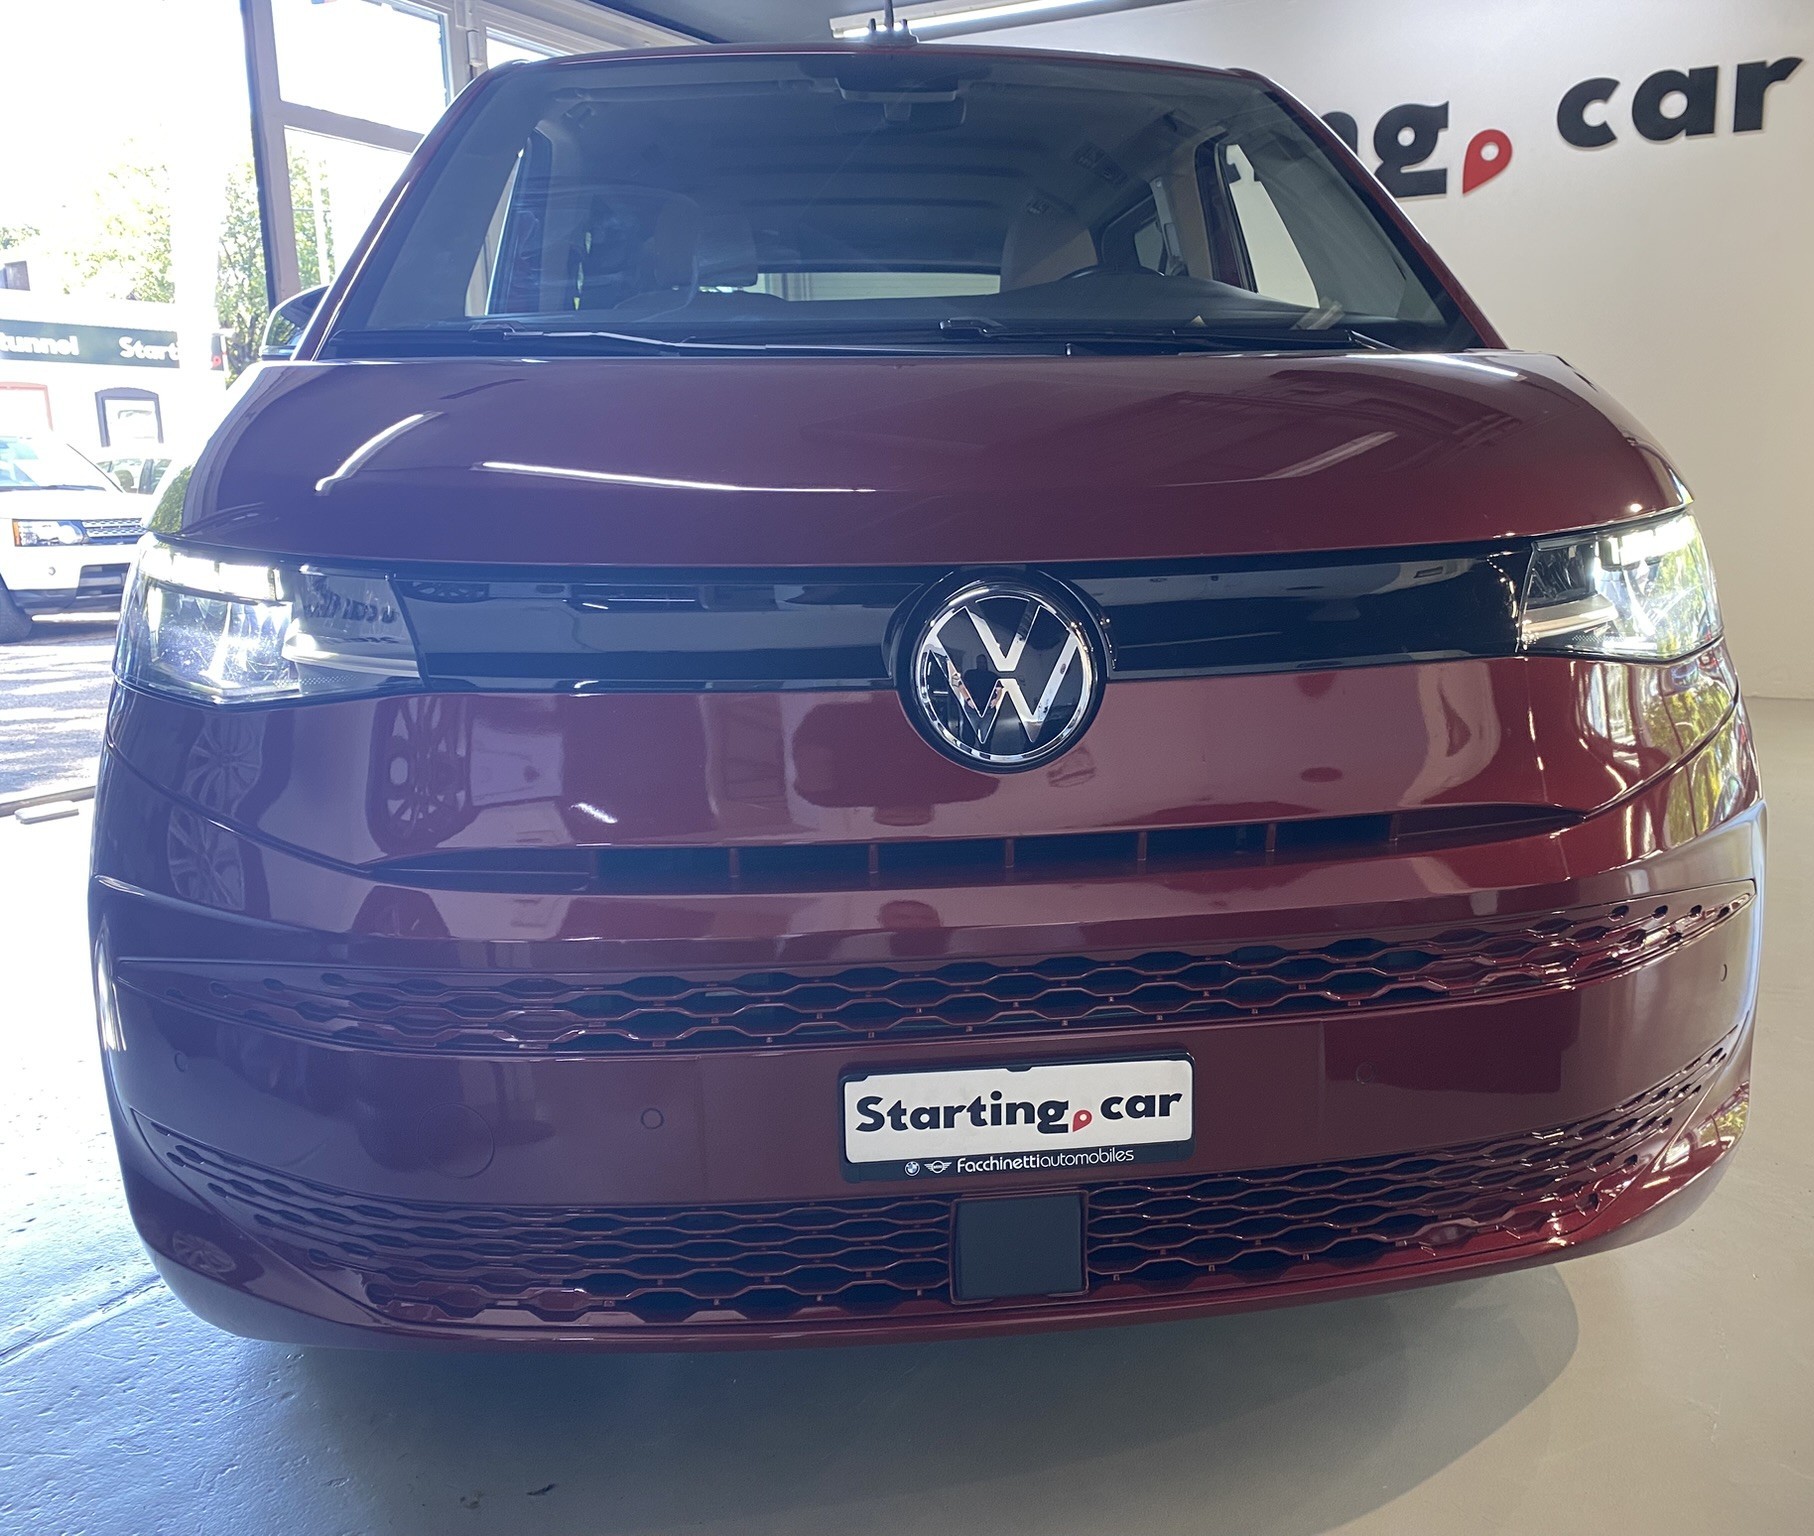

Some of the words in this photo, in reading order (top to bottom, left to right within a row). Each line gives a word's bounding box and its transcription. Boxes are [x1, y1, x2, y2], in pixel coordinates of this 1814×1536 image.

[1557, 57, 1804, 149] car
[855, 1090, 1069, 1134] Starting
[1100, 1092, 1183, 1121] car
